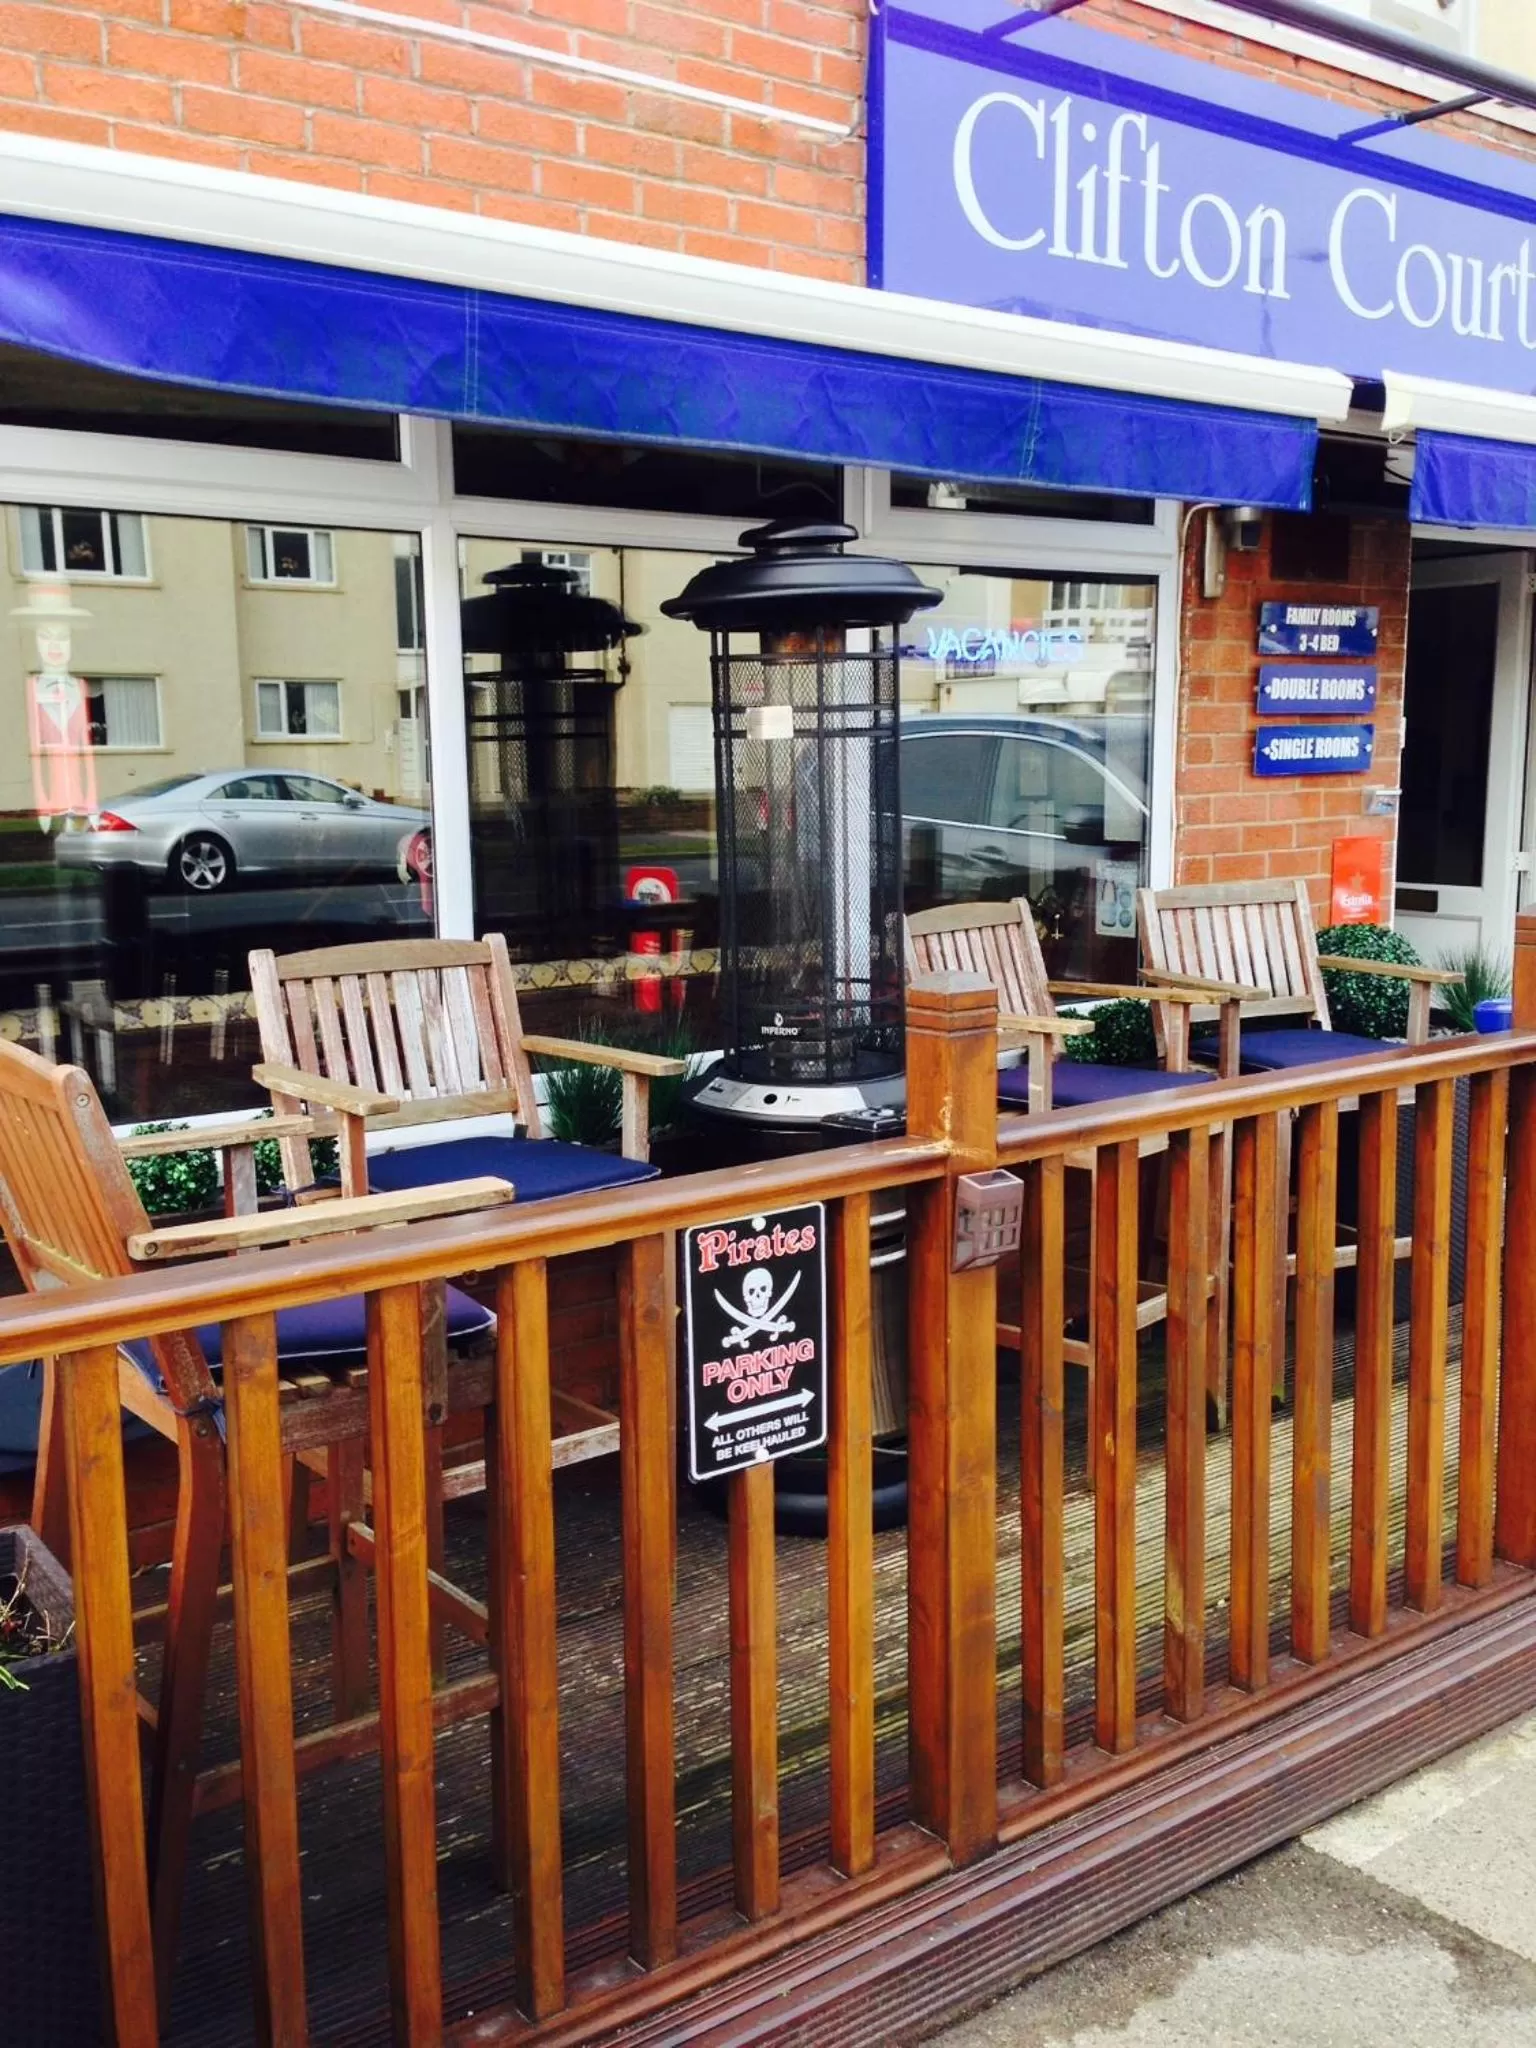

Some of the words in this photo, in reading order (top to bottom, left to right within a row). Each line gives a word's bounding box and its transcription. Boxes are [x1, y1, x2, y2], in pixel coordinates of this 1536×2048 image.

[953, 91, 1290, 299] Clifton
[1328, 187, 1536, 350] Court
[1286, 607, 1320, 625] FAMILY
[1321, 608, 1357, 627] ROOMS
[927, 627, 1082, 662] VACANCIES
[1320, 635, 1340, 652] BED
[1270, 677, 1318, 700] DOUBLE
[1320, 678, 1365, 701] ROOMS
[1269, 738, 1313, 761] SINGLE
[1315, 736, 1360, 759] ROOMS
[761, 1026, 798, 1036] INFERNO
[697, 1223, 816, 1273] Pirates
[702, 1338, 815, 1386] PARKING
[727, 1366, 794, 1403] ONLY
[712, 1433, 734, 1448] ALL
[736, 1419, 781, 1441] OTHERS
[783, 1411, 809, 1427] WILL
[716, 1448, 732, 1461] BE
[734, 1426, 806, 1456] KEELHAULED
